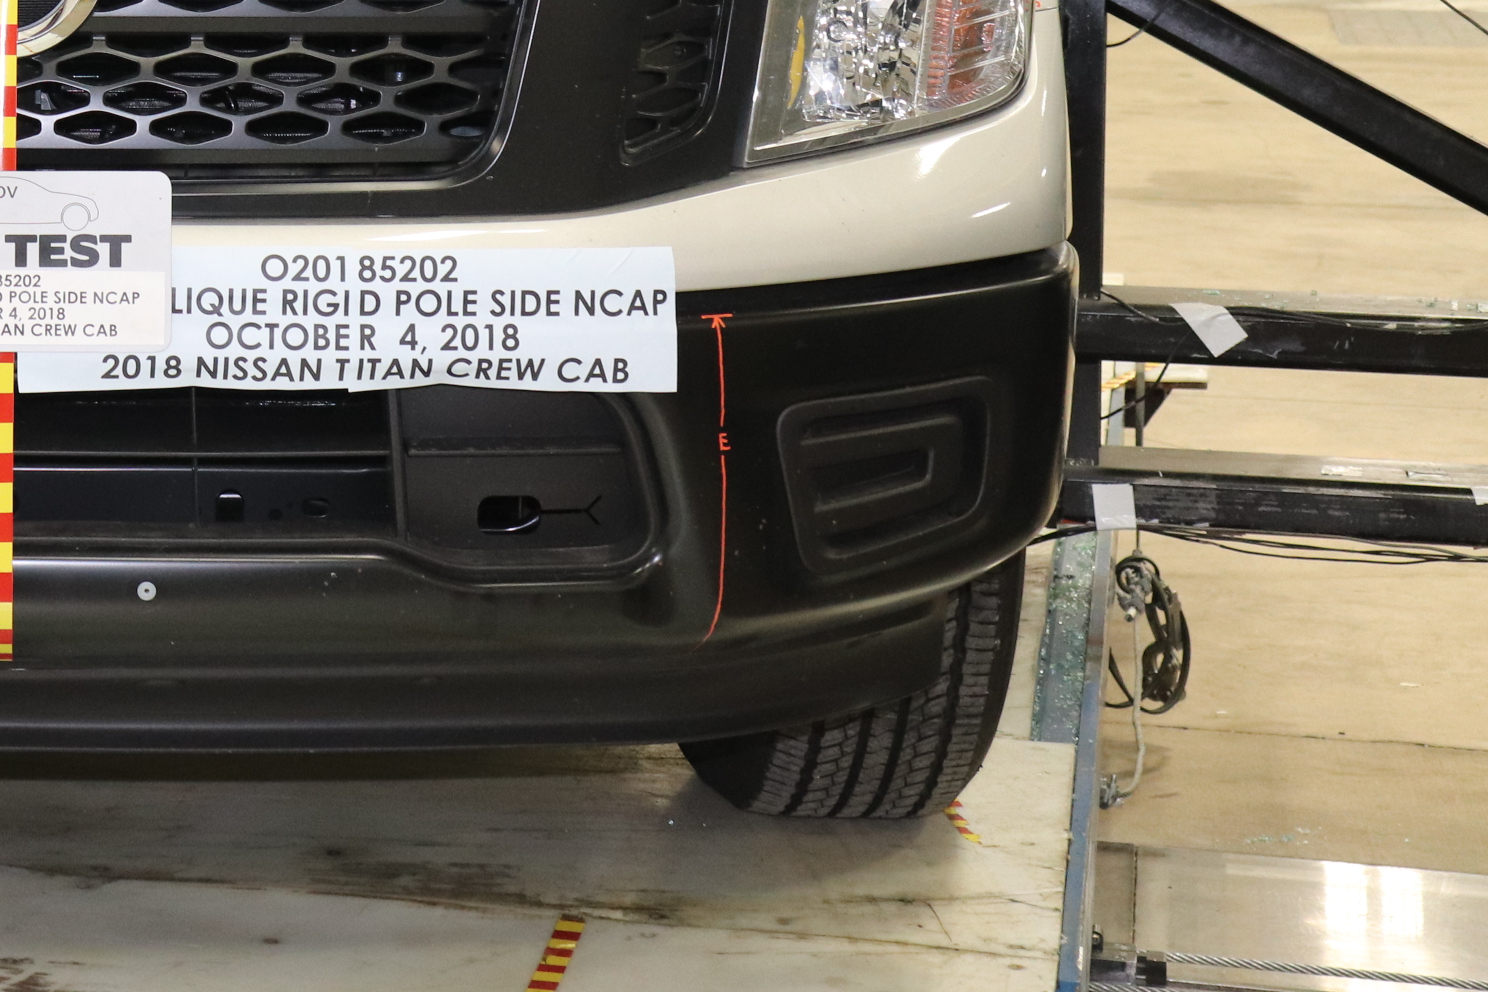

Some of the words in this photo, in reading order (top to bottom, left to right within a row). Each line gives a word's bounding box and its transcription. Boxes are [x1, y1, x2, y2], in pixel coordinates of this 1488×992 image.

[4, 234, 132, 268] TEST
[9, 290, 49, 304] POLE
[53, 291, 88, 305] SIDE
[93, 291, 141, 305] NCAP
[171, 287, 268, 317] LIQUE
[281, 288, 381, 317] RIGID
[395, 289, 478, 317] POLE
[489, 289, 560, 317] SIDE
[574, 289, 668, 317] NCAP
[9, 307, 23, 323] 4,
[28, 307, 66, 321] 2018
[29, 323, 78, 337] CREW
[83, 323, 118, 337] CAB
[205, 321, 377, 351] OCTOBER
[399, 323, 427, 355] 4,
[440, 323, 520, 351] 2018
[100, 354, 182, 379] 2018
[195, 356, 322, 382] NISSAN
[335, 357, 433, 381] TITAN
[446, 358, 545, 382] CREW
[557, 357, 629, 384] CAB
[718, 432, 731, 451] E
